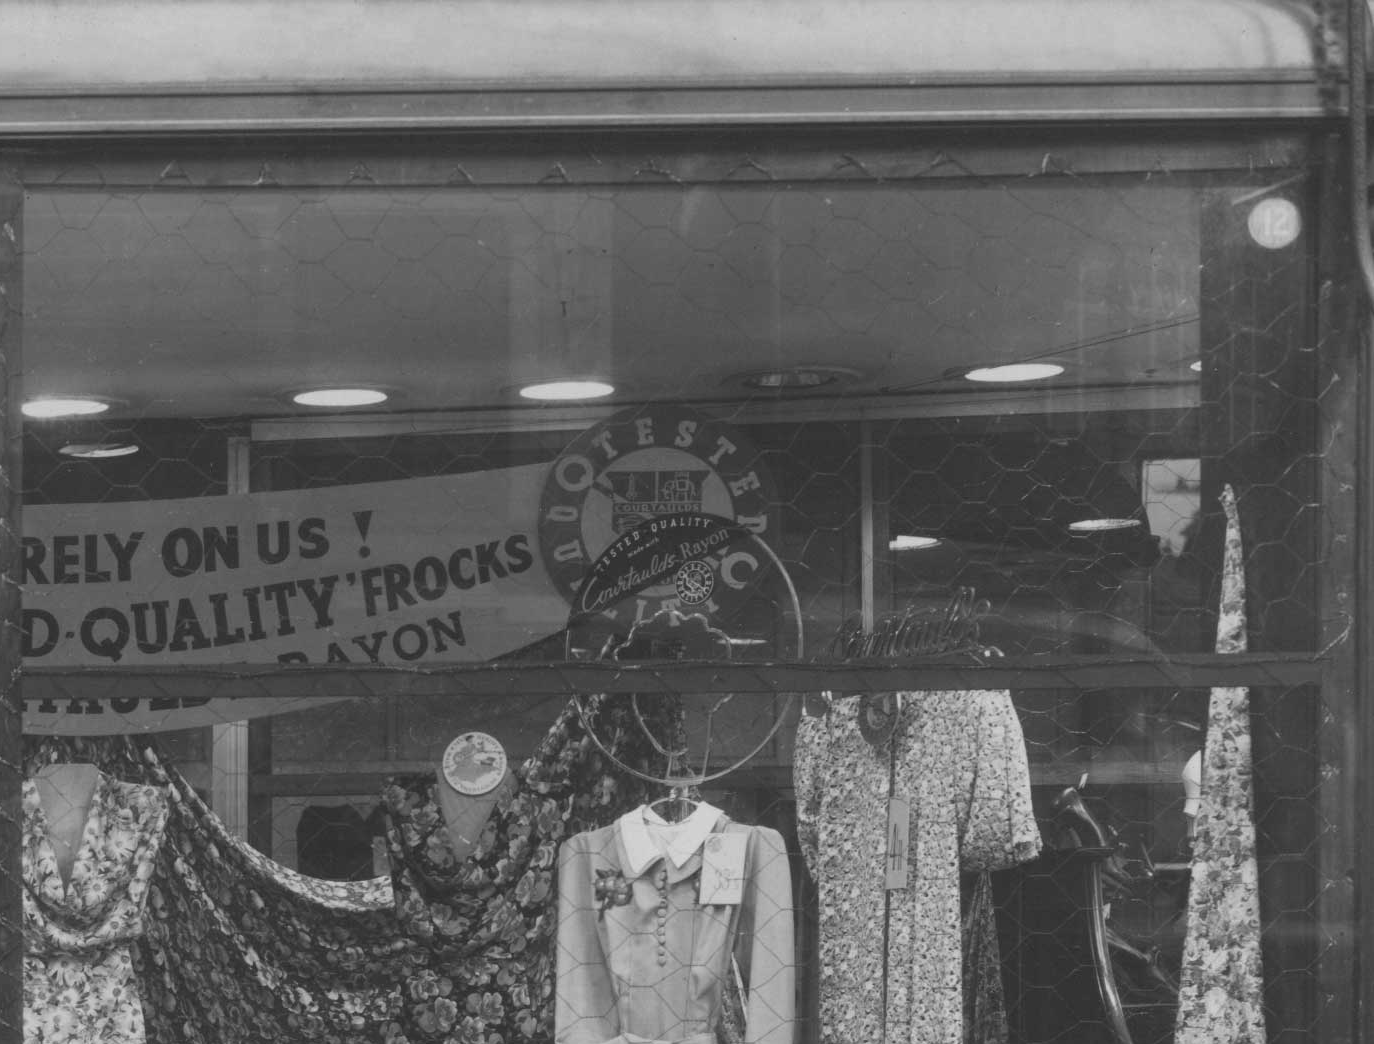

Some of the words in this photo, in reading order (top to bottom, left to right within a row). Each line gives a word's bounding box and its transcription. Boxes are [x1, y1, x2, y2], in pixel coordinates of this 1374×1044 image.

[21, 530, 145, 585] RELY
[161, 526, 240, 578] ON
[256, 517, 330, 565] US
[361, 534, 534, 617] FROCKS
[582, 553, 678, 613] Courtaulds
[679, 528, 730, 560] Rayon
